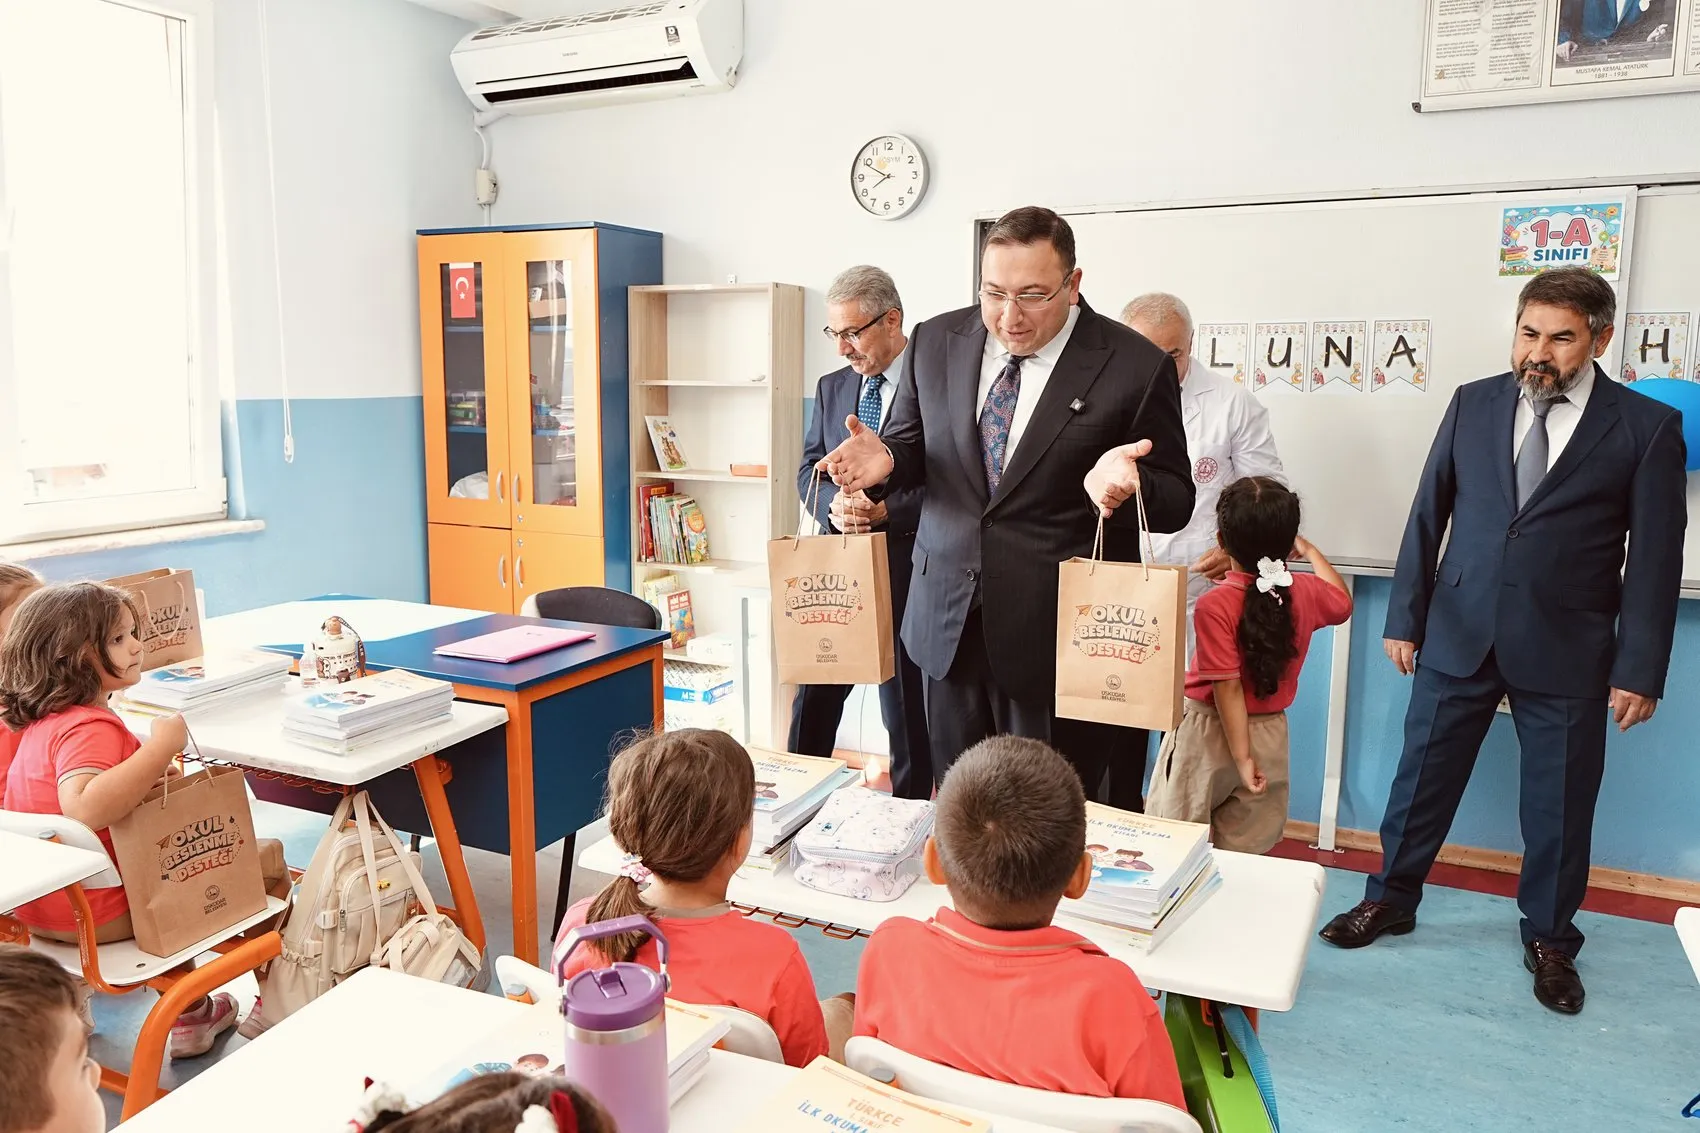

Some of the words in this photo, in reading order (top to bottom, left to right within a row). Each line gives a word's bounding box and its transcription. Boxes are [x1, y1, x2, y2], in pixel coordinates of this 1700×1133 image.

[872, 147, 878, 156] 11
[883, 141, 893, 151] 12
[863, 157, 873, 166] 10
[907, 155, 914, 164] 2
[857, 173, 865, 182] 9
[912, 170, 918, 180] 3
[861, 188, 869, 197] 8
[907, 186, 914, 195] 4
[870, 198, 877, 207] 7
[883, 201, 891, 210] 6
[898, 196, 905, 206] 5
[1530, 217, 1592, 247] 1-A
[1533, 248, 1588, 261] SINIFI
[1639, 328, 1670, 363] H
[799, 574, 848, 592] OKUL
[787, 593, 857, 610] BESLENME
[1091, 604, 1146, 627] OKUL
[1078, 624, 1155, 646] BESLENME
[171, 815, 225, 847] OKUL
[163, 833, 236, 870] BESLENME
[176, 848, 233, 882] DESTEĞİ
[797, 1099, 822, 1117] İLK
